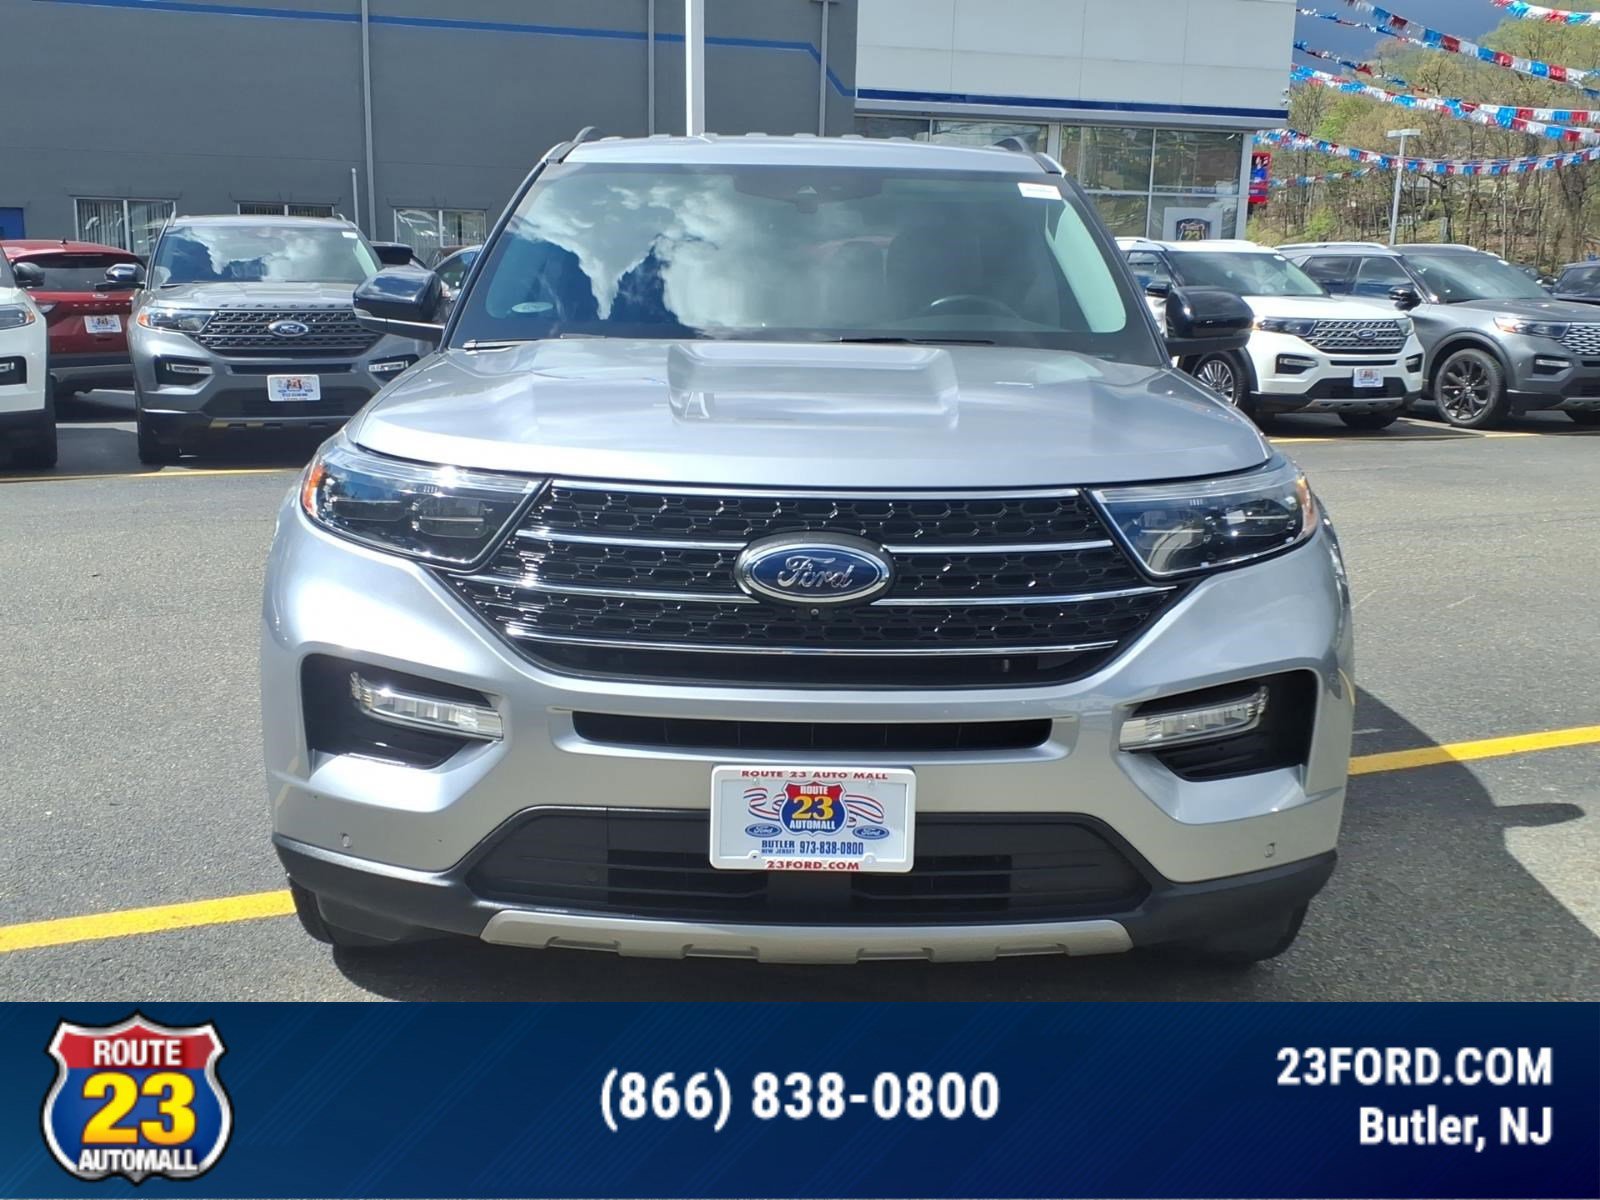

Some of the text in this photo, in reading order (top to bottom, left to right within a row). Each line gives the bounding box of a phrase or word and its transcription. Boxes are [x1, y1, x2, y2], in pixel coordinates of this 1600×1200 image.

[777, 555, 855, 588] Ford
[741, 770, 783, 778] ROUTE
[813, 771, 848, 779] AUTO
[800, 785, 829, 795] ROUTE
[791, 796, 834, 820] 23
[789, 820, 836, 831] AUTOMALL
[762, 840, 795, 848] BUTLER
[799, 841, 864, 855] 973-838-0800
[767, 860, 860, 870] 23FORD.COM
